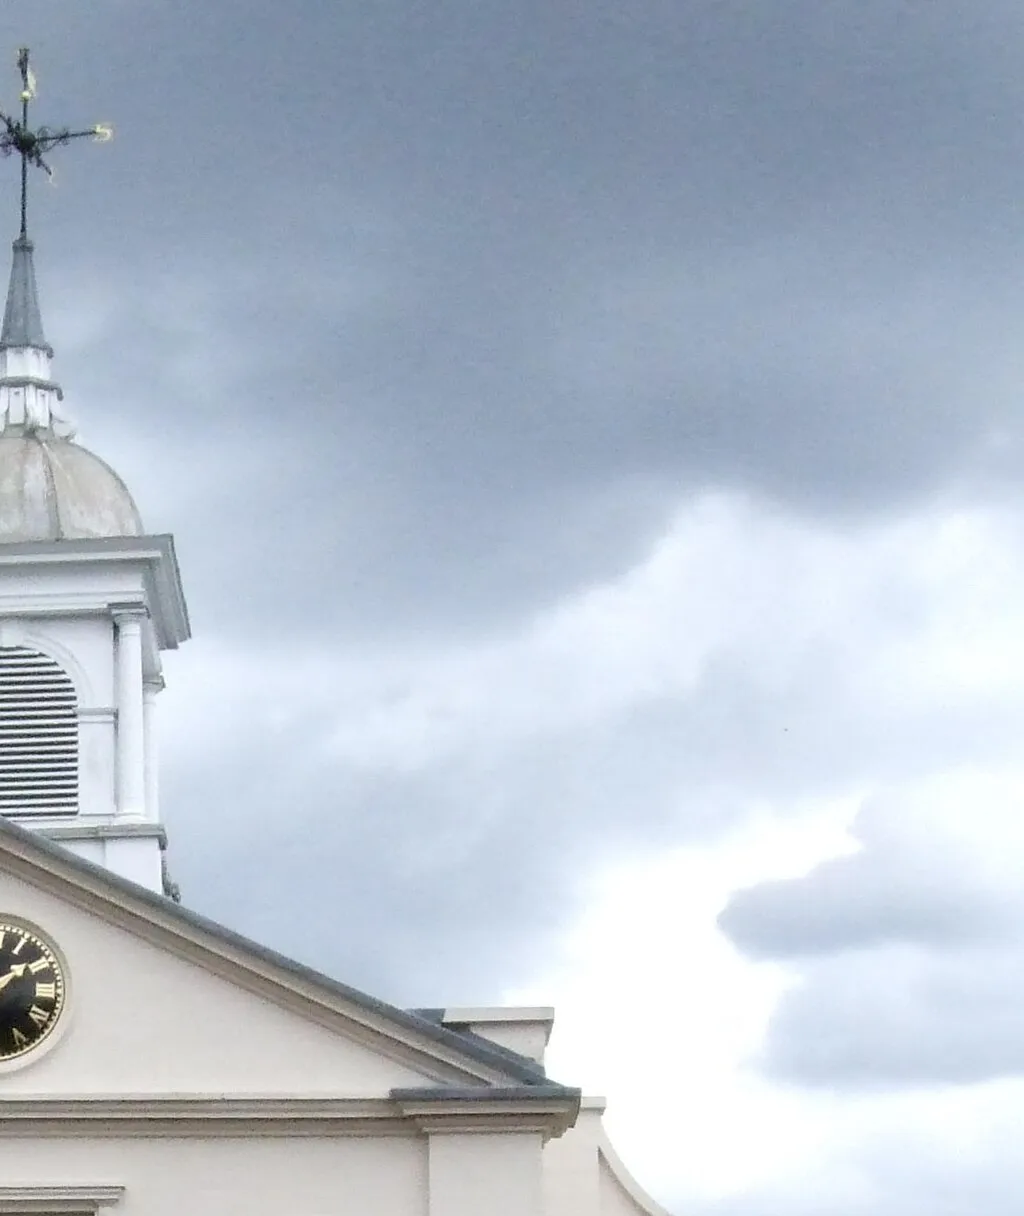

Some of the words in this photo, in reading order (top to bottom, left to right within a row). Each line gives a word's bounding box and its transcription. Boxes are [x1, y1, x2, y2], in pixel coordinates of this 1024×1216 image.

[11, 936, 28, 955] I
[27, 956, 50, 975] II
[35, 981, 56, 1000] III
[12, 1027, 29, 1048] V
